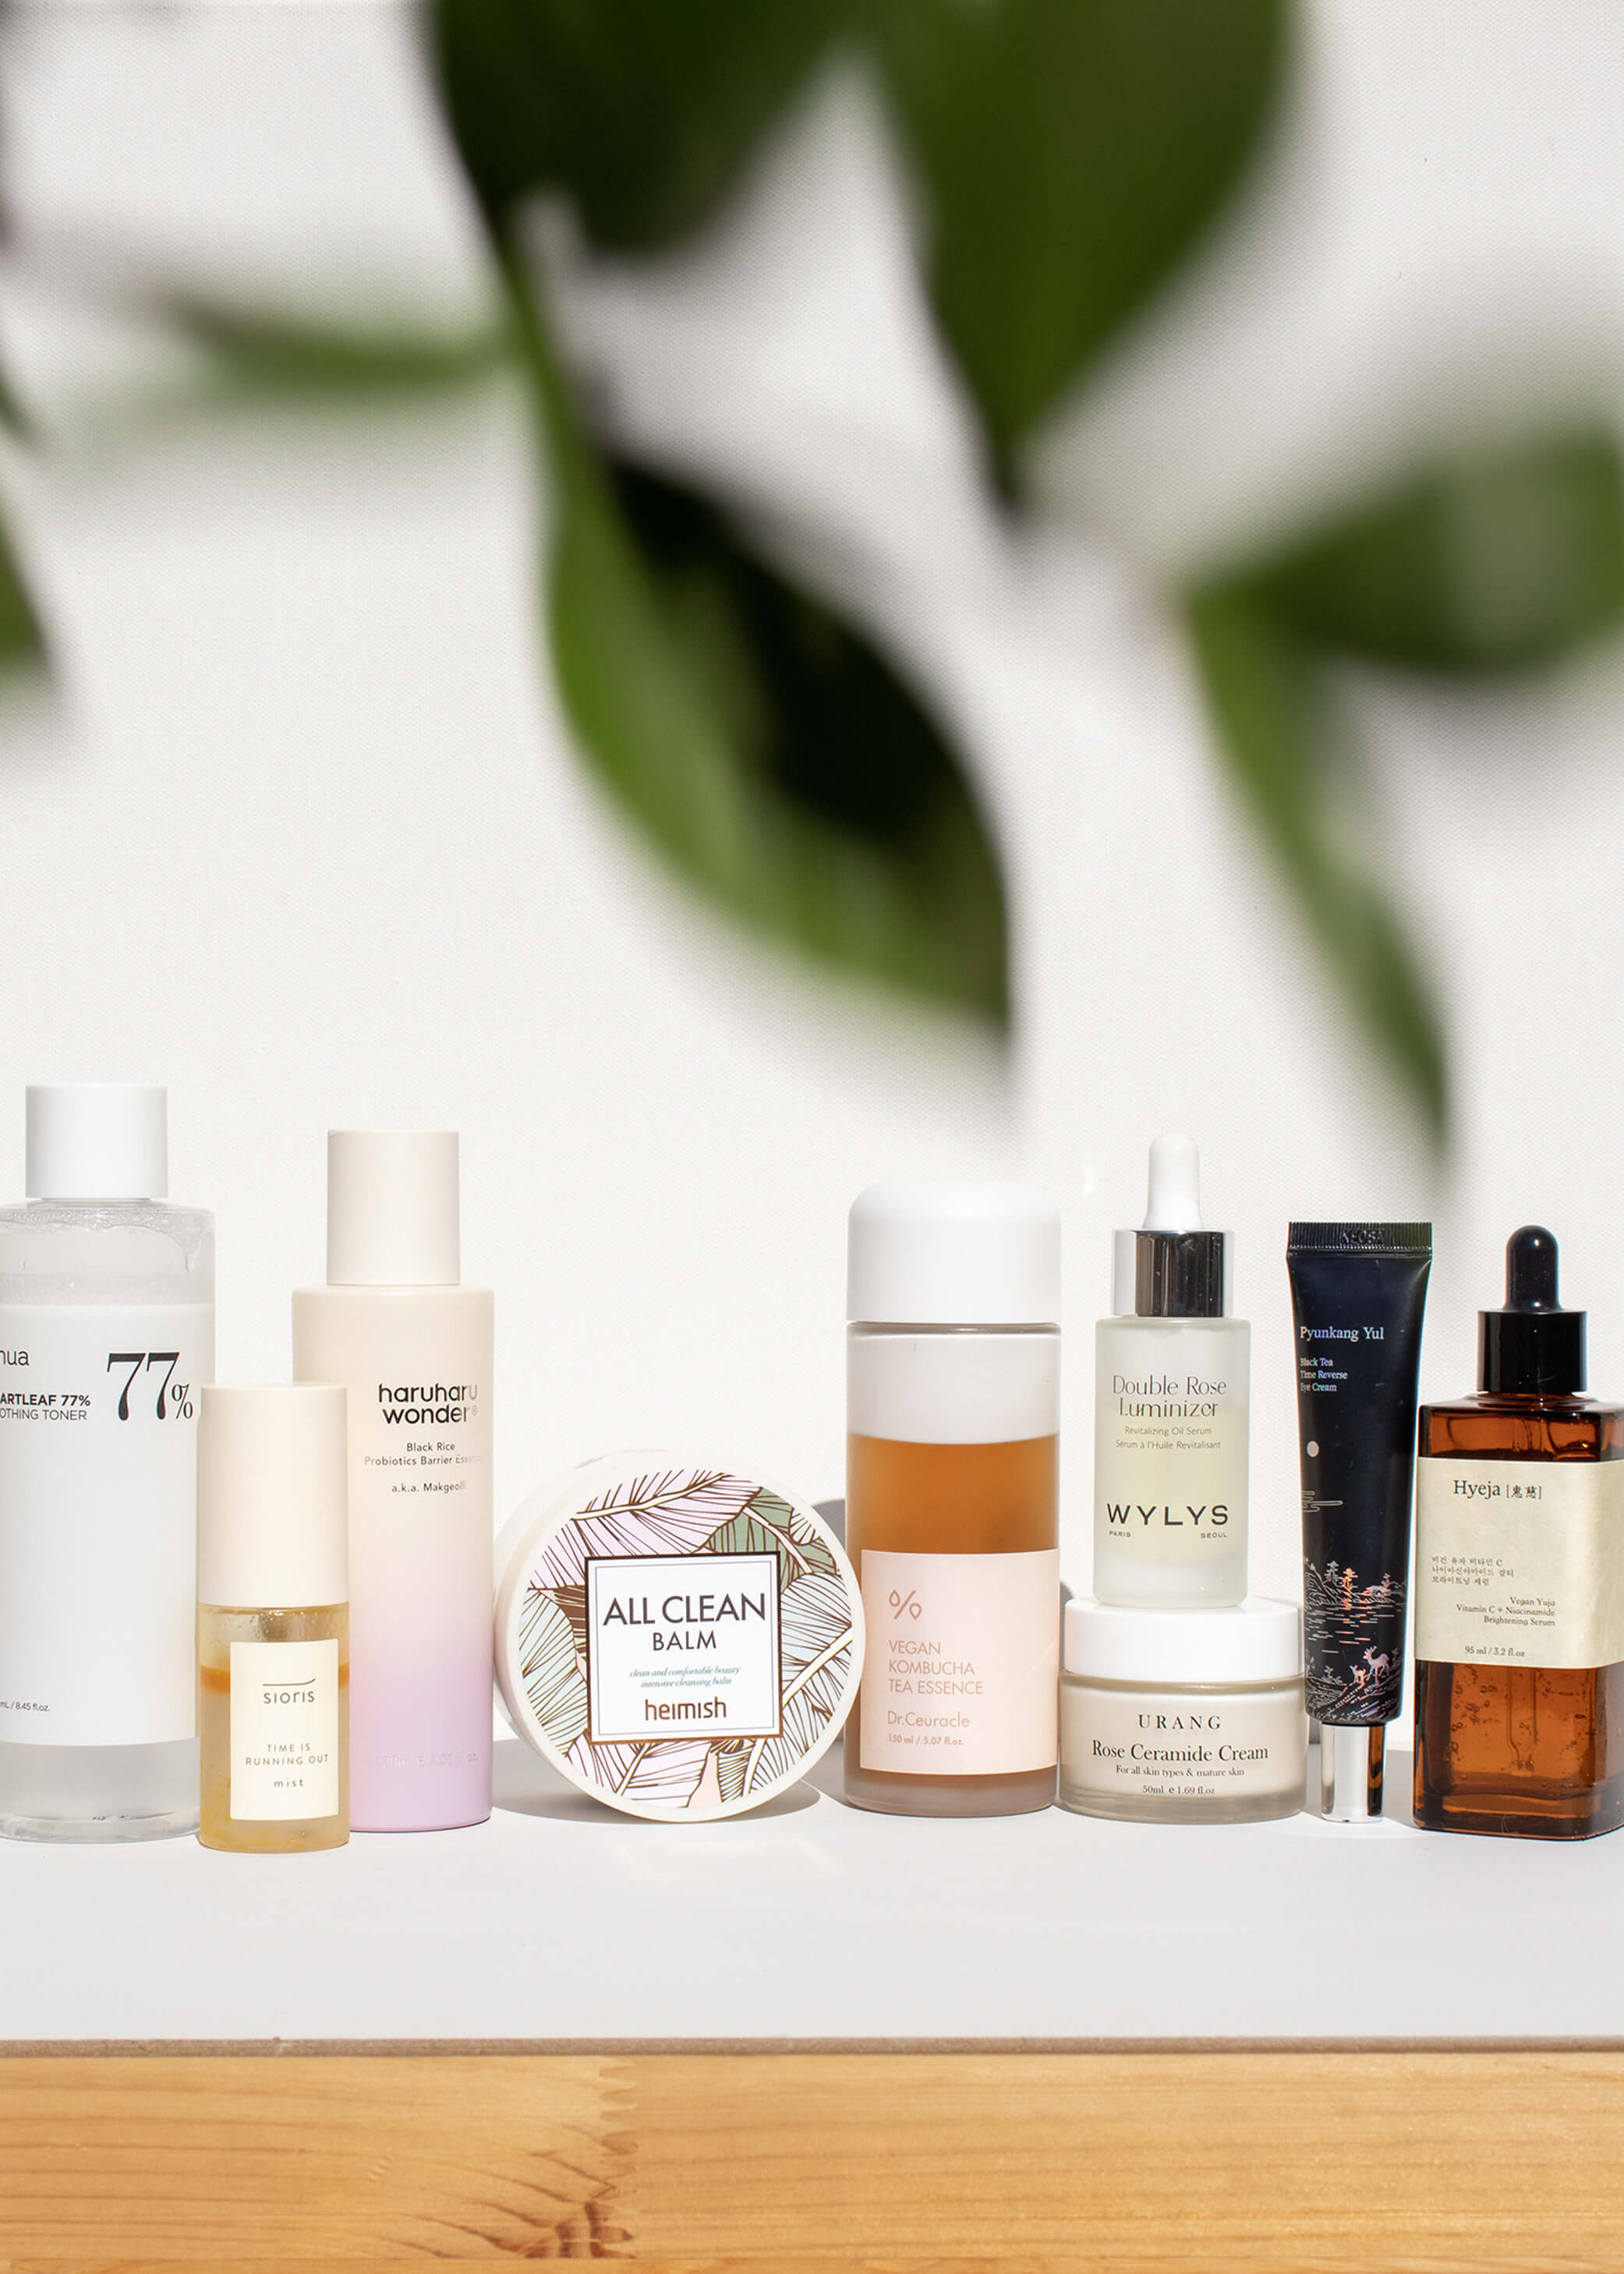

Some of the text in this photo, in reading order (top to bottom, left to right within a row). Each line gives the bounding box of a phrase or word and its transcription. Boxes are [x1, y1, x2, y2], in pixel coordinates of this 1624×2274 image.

[1300, 1327, 1385, 1342] Pyunkang Yul
[1300, 1358, 1334, 1367] Black Tea
[1300, 1370, 1348, 1379] Time Reverse
[106, 1352, 193, 1421] 77%
[1113, 1374, 1227, 1395] Double Rose
[1300, 1383, 1338, 1393] Eye Cream
[378, 1383, 478, 1403] haruharu
[61, 1395, 91, 1406] 77%
[1119, 1397, 1219, 1418] Luminizer
[42, 1409, 87, 1420] TONER
[1124, 1426, 1212, 1437] Revitalizing Oil Serum
[406, 1441, 455, 1452] Black Rice
[1140, 1440, 1145, 1449] à
[1176, 1441, 1222, 1450] Revitalisant
[364, 1455, 417, 1466] Probiotics
[420, 1455, 453, 1465] Barrier
[391, 1484, 420, 1493] a.k.a.
[1453, 1480, 1502, 1500] Hyeja
[1106, 1503, 1229, 1526] WYLYS
[1510, 1597, 1555, 1607] Vegan Yuja
[603, 1593, 766, 1626] ALL CLEAN
[1456, 1604, 1487, 1613] Vitamin
[1505, 1607, 1555, 1616] Niacinamide
[1484, 1615, 1555, 1626] Brightening Serum
[653, 1629, 717, 1651] BALM
[888, 1640, 941, 1654] VEGAN
[629, 1665, 741, 1677] clean and comfortable beauty
[888, 1659, 975, 1675] KOMBUCHA
[712, 1676, 733, 1685] balm
[888, 1678, 983, 1695] TEA ESSENCE
[645, 1696, 727, 1721] heimish
[1138, 1714, 1222, 1730] URANG
[889, 1734, 902, 1744] 150
[904, 1735, 914, 1744] ml
[923, 1736, 942, 1745] 5.07
[267, 1744, 295, 1752] TIME
[1092, 1739, 1268, 1762] Rose Ceramide Cream
[246, 1754, 328, 1766] RUNNING OUT
[1116, 1764, 1130, 1774] For
[1130, 1766, 1141, 1775] all
[1142, 1767, 1160, 1777] skin
[1162, 1769, 1184, 1778] types
[1186, 1768, 1194, 1777] &
[1228, 1767, 1245, 1776] skin
[274, 1778, 304, 1788] mist
[1142, 1784, 1164, 1794] 50ml
[1177, 1785, 1195, 1794] 1.69
